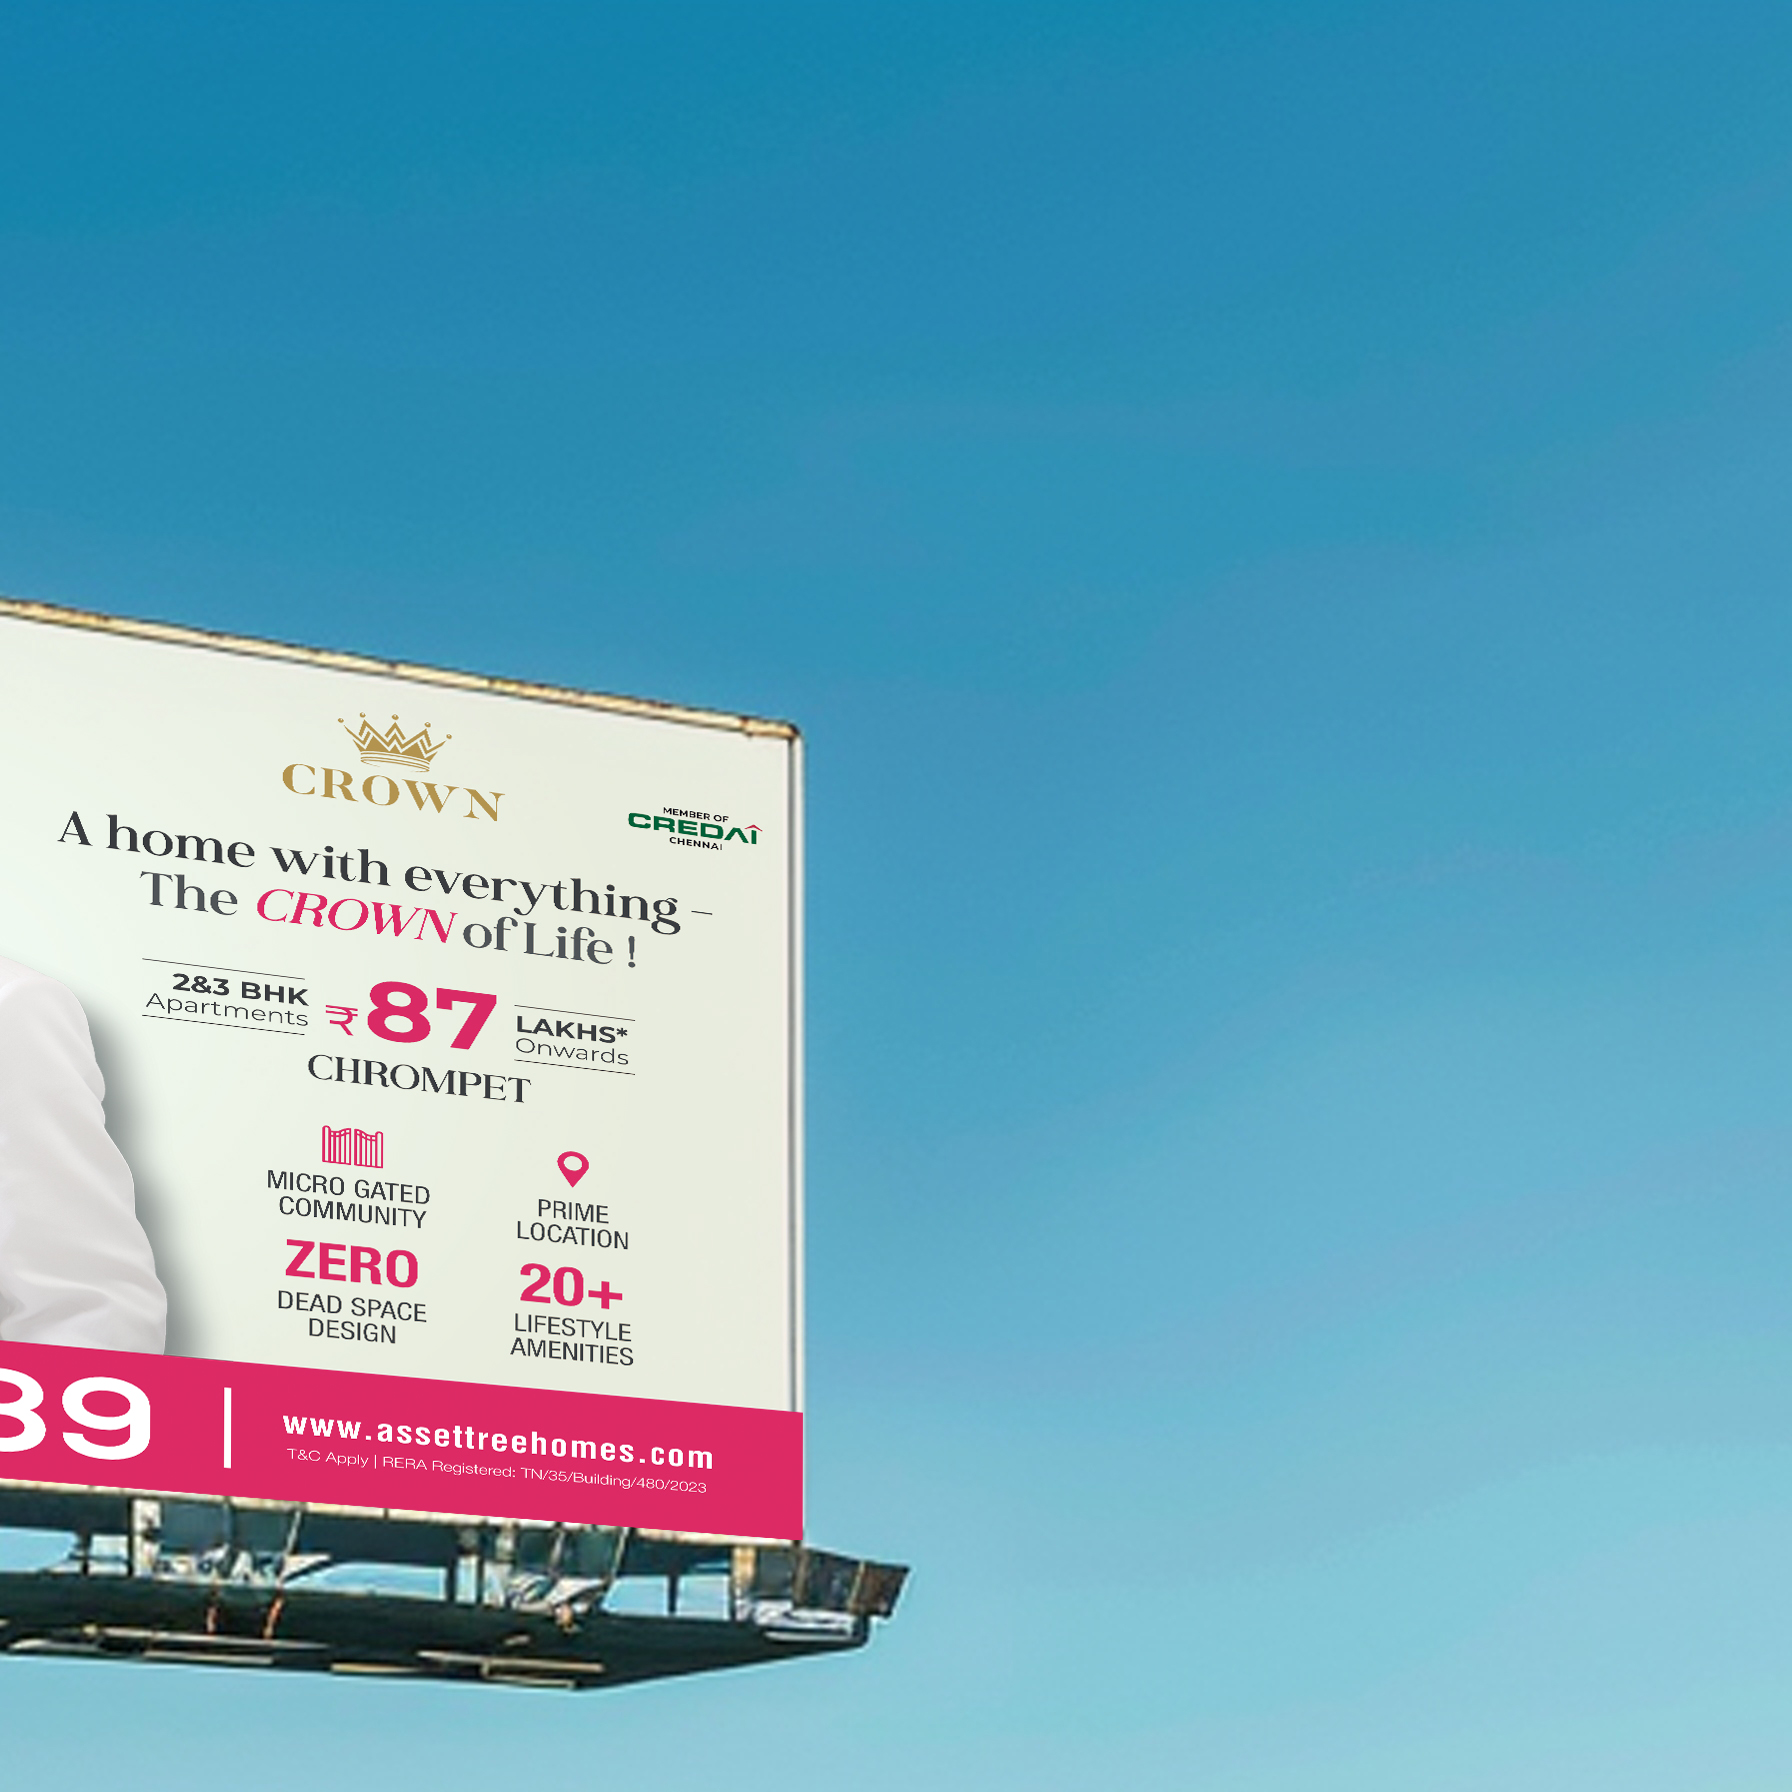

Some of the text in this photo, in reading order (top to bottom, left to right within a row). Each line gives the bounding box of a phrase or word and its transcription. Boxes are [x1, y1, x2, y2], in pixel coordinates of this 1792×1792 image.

[282, 763, 506, 822] CROWN
[663, 807, 729, 823] MEMBER OF
[669, 836, 723, 851] CHENNAI
[58, 810, 93, 846] A
[106, 813, 255, 868] home
[269, 845, 391, 887] with
[404, 865, 682, 935] everything
[139, 870, 238, 916] The
[257, 888, 458, 943] CROWN
[463, 916, 518, 952] of
[523, 921, 613, 965] Life
[172, 972, 309, 1007] 2&3 BHK
[146, 992, 309, 1028] Apartments
[515, 1038, 630, 1066] Onwards
[307, 1054, 532, 1104] CHROMPET
[267, 1169, 431, 1206] MICRO GATED
[279, 1196, 427, 1229] COMMUNITY
[537, 1198, 609, 1225] PRIME
[517, 1221, 629, 1250] LOCATION
[285, 1238, 419, 1288] ZERO
[519, 1262, 623, 1310] 20+
[278, 1290, 427, 1323] DEAD SPACE
[309, 1318, 396, 1344] DESIGN
[514, 1313, 632, 1342] LIFESTYLE
[510, 1337, 634, 1366] AMENITIES
[282, 1415, 714, 1470] www.assettreehomes.com
[287, 1448, 321, 1462] T&C
[325, 1452, 369, 1468] Apply
[383, 1456, 427, 1471] RERA
[432, 1460, 516, 1478] Registered:
[520, 1467, 708, 1494] TN/35/Building/480/2023
